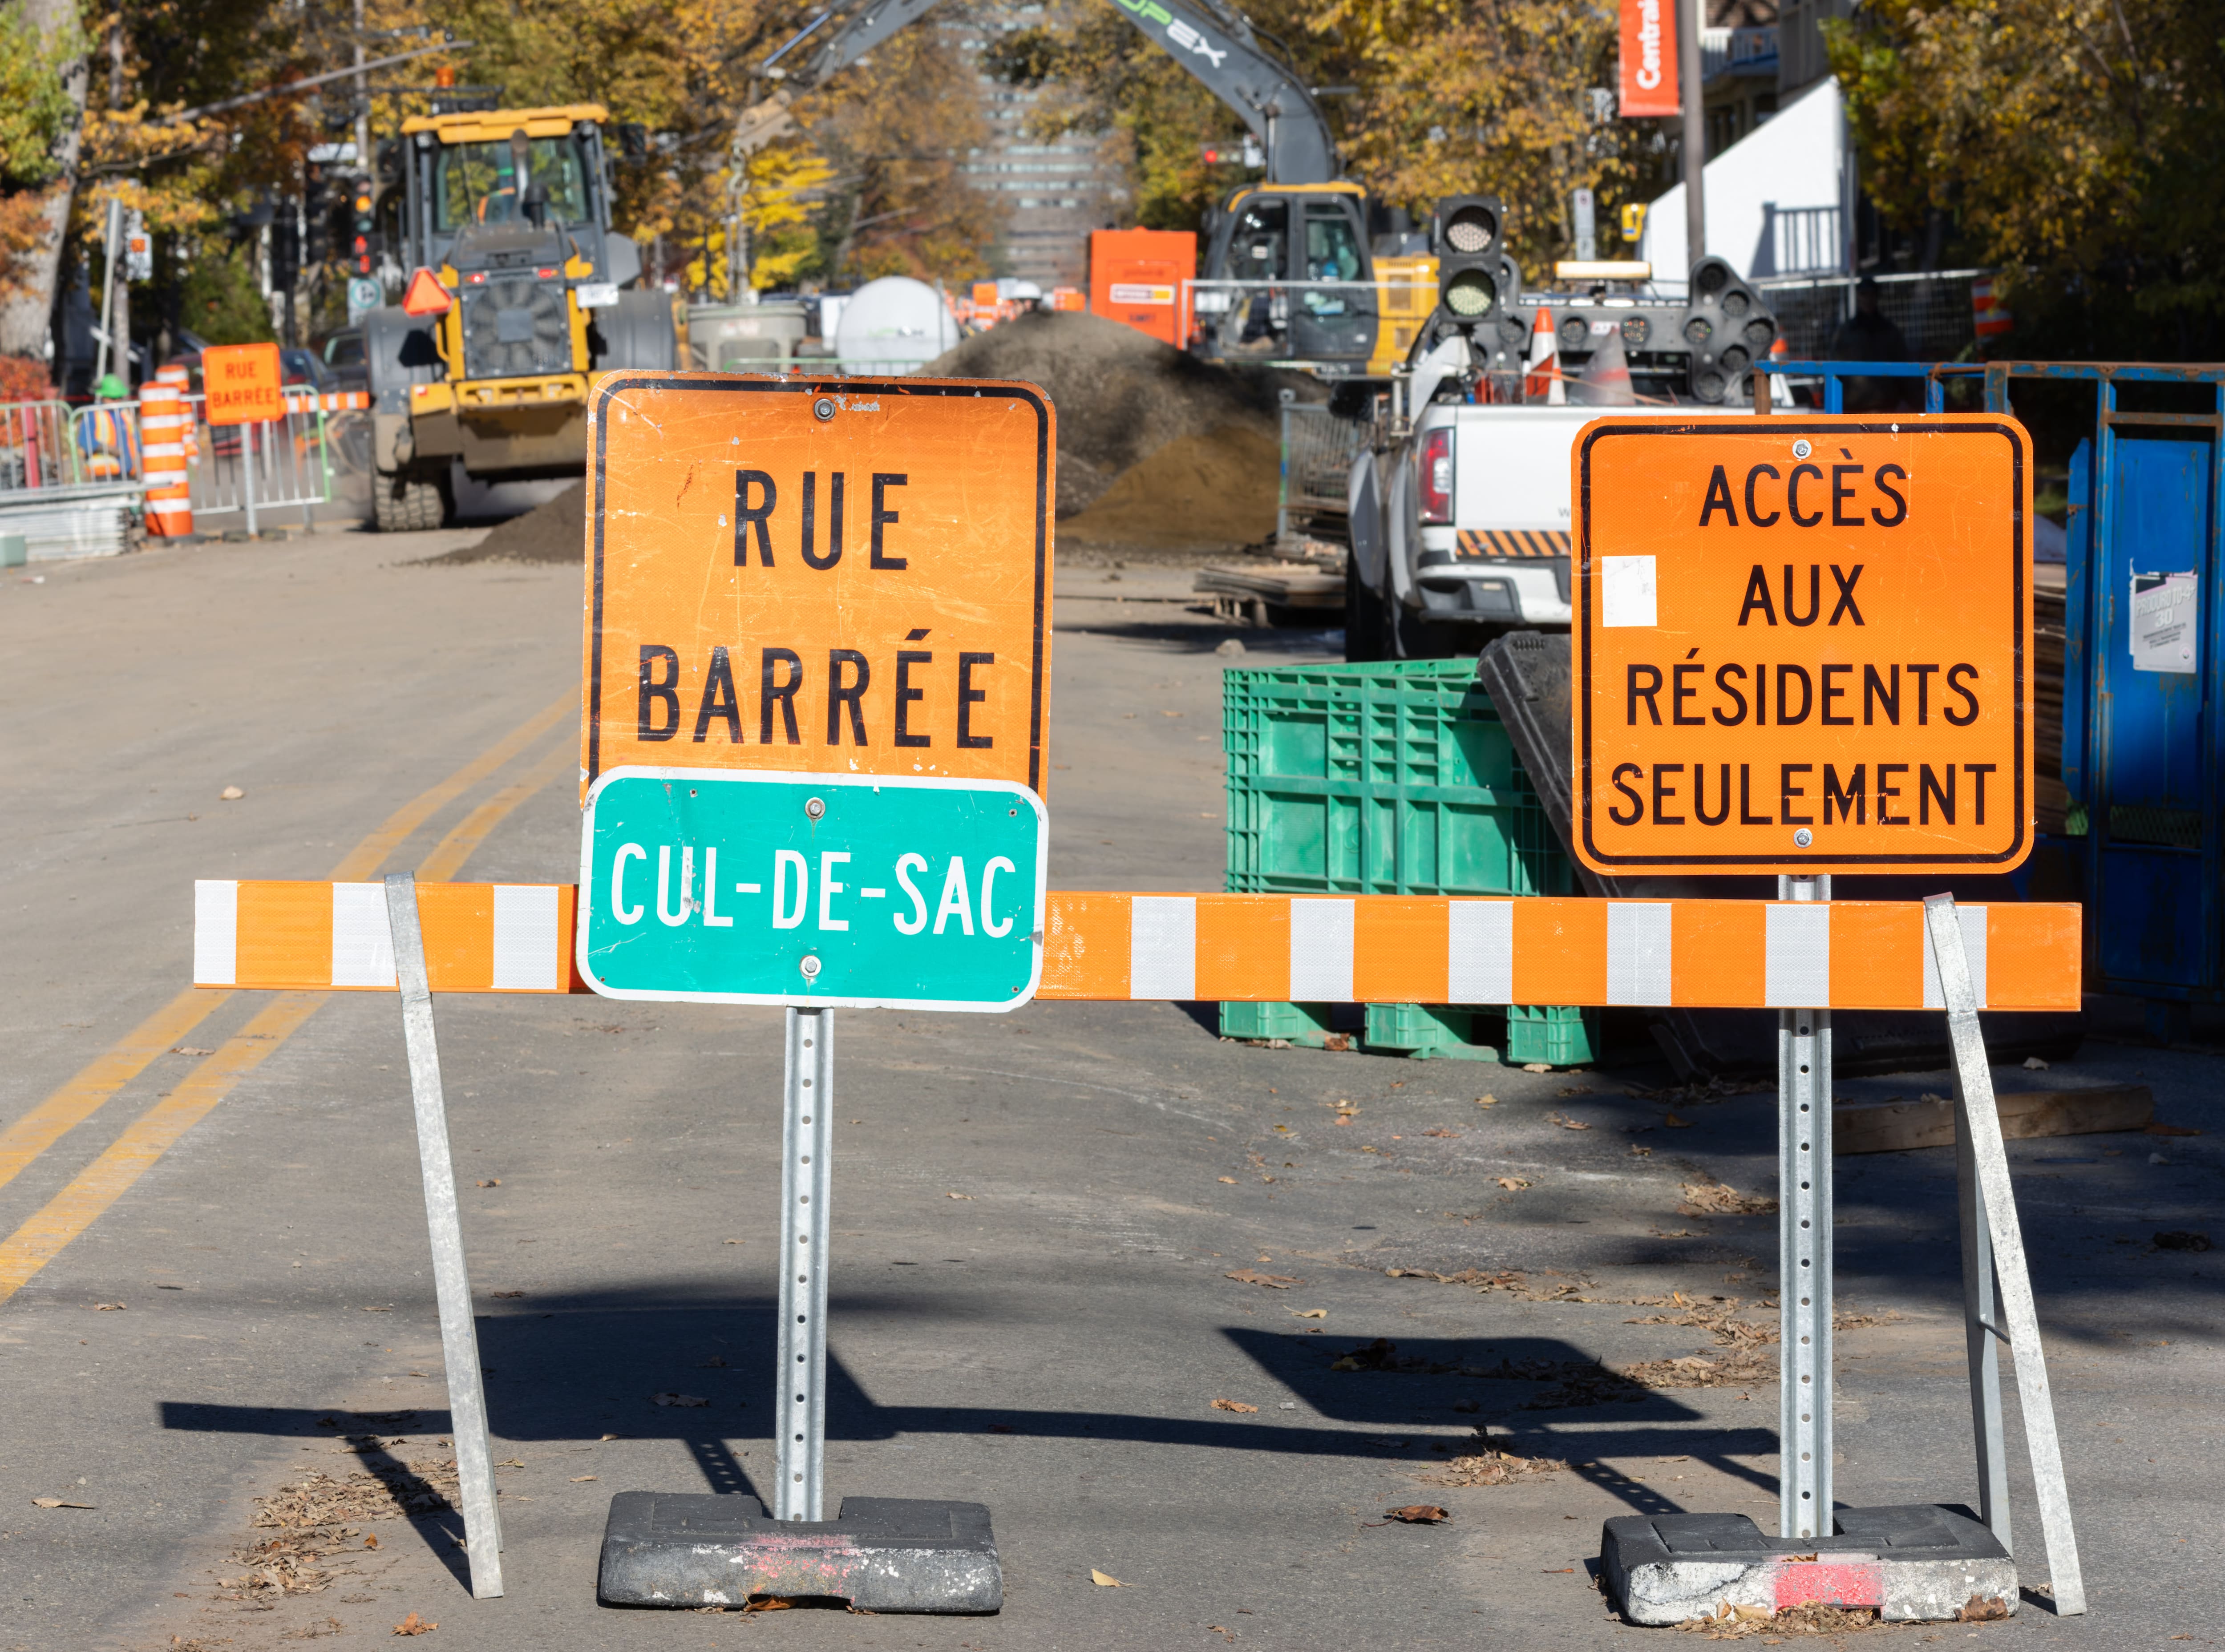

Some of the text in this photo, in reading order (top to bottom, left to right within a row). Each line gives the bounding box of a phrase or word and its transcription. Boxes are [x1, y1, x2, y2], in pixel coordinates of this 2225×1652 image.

[212, 386, 275, 408] BARRÉE
[225, 361, 257, 380] RUE
[734, 470, 908, 570] RUE
[1699, 448, 1907, 528] ACCÈS
[1738, 565, 1865, 626] AUX
[2155, 609, 2173, 628] 30
[637, 628, 995, 749] BARRÉE
[1627, 648, 1979, 727] RÉSIDENTS
[1609, 763, 1997, 826] SEULEMENT
[611, 842, 1016, 939] CUL-DE-SAC
